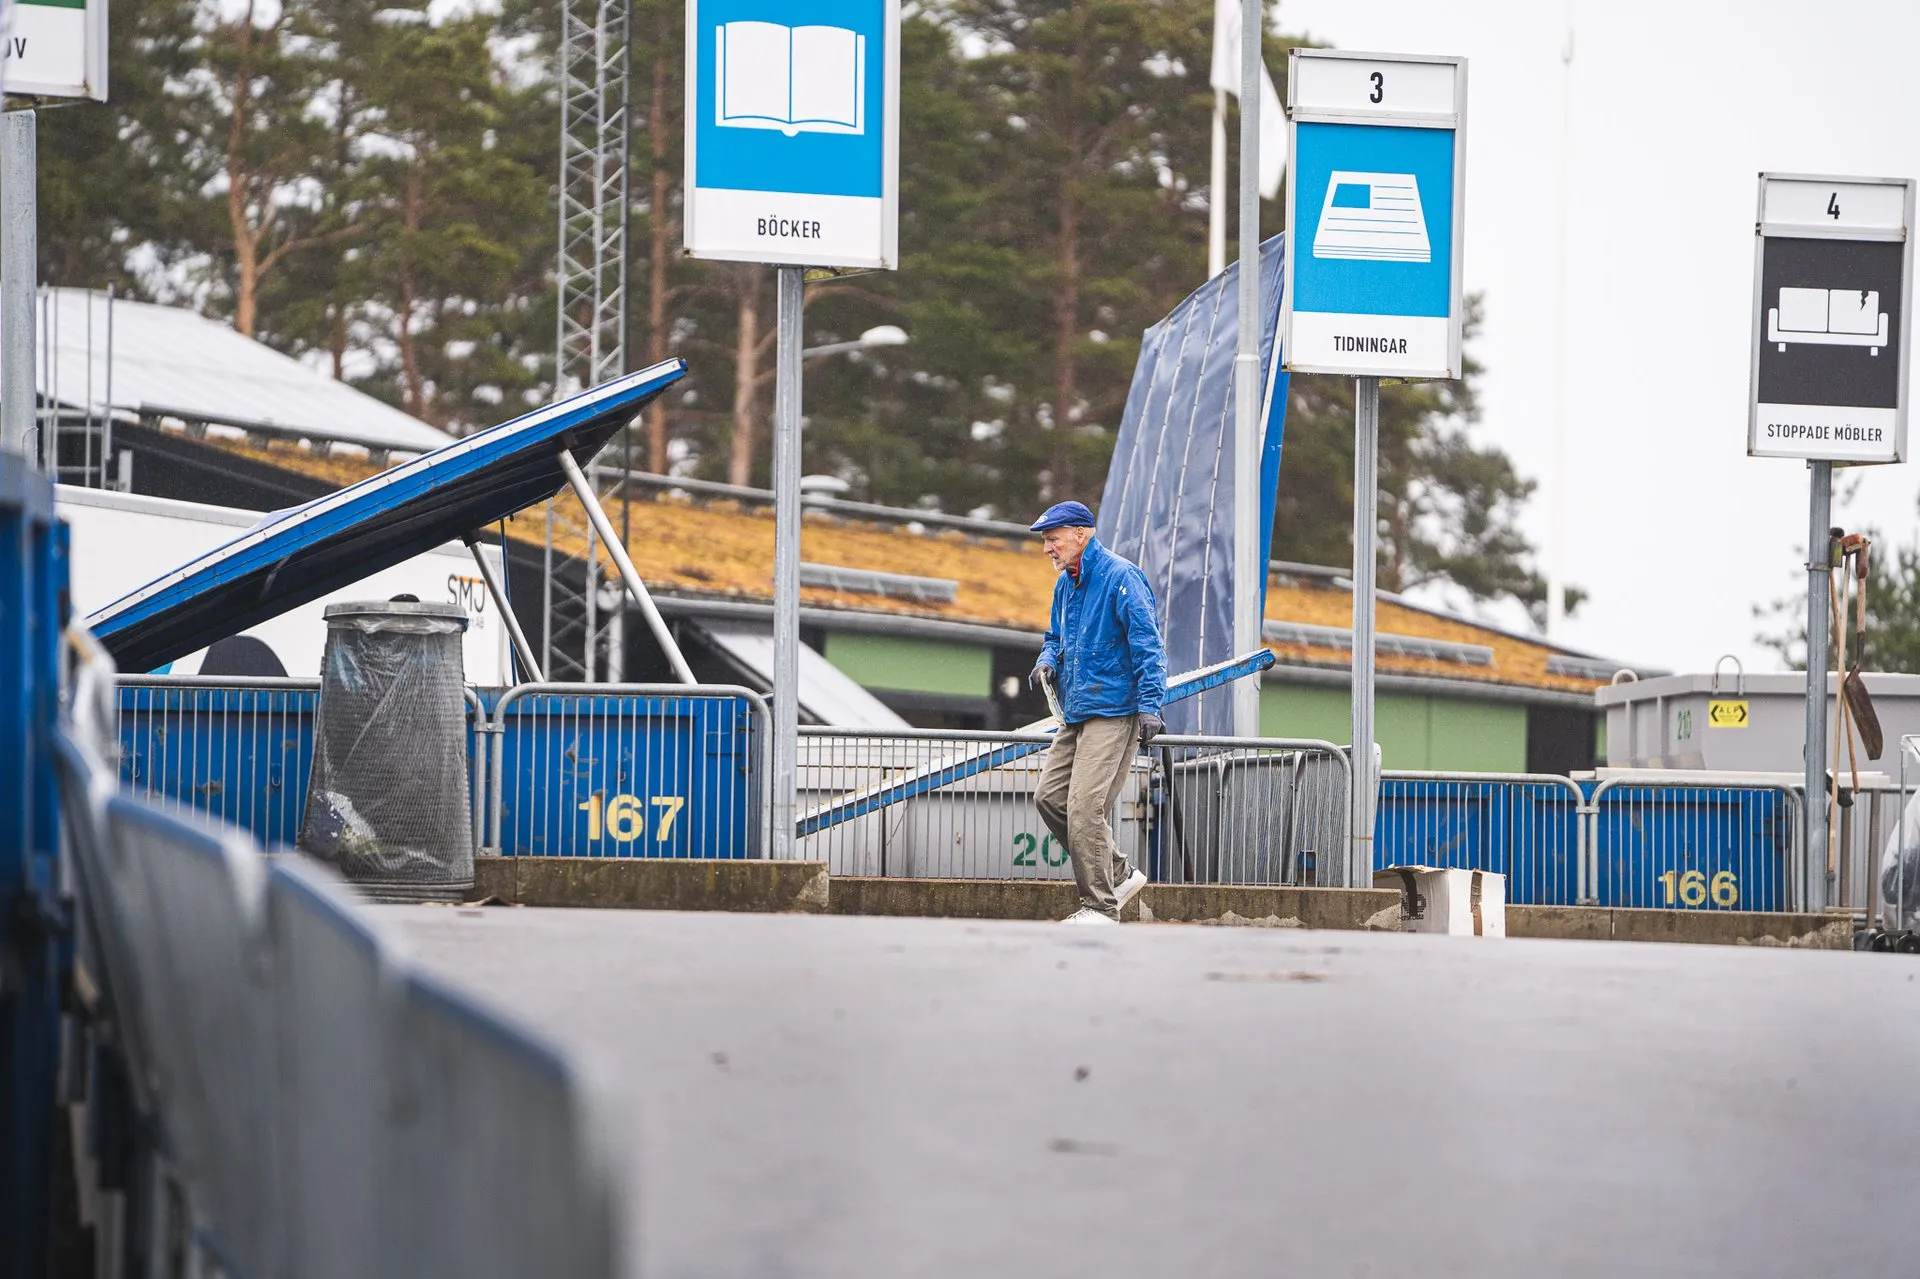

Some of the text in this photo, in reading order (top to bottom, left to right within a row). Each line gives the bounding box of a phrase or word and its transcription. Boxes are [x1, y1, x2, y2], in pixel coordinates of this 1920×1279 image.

[1370, 71, 1384, 104] 3
[1827, 192, 1840, 220] 4
[757, 214, 821, 239] BÖCKER
[1333, 335, 1407, 354] TIDNINGAR
[1767, 423, 1882, 442] STOPPADE MÖBLER
[447, 573, 486, 613] SMJ
[578, 793, 684, 842] 167
[1657, 869, 1739, 907] 166
